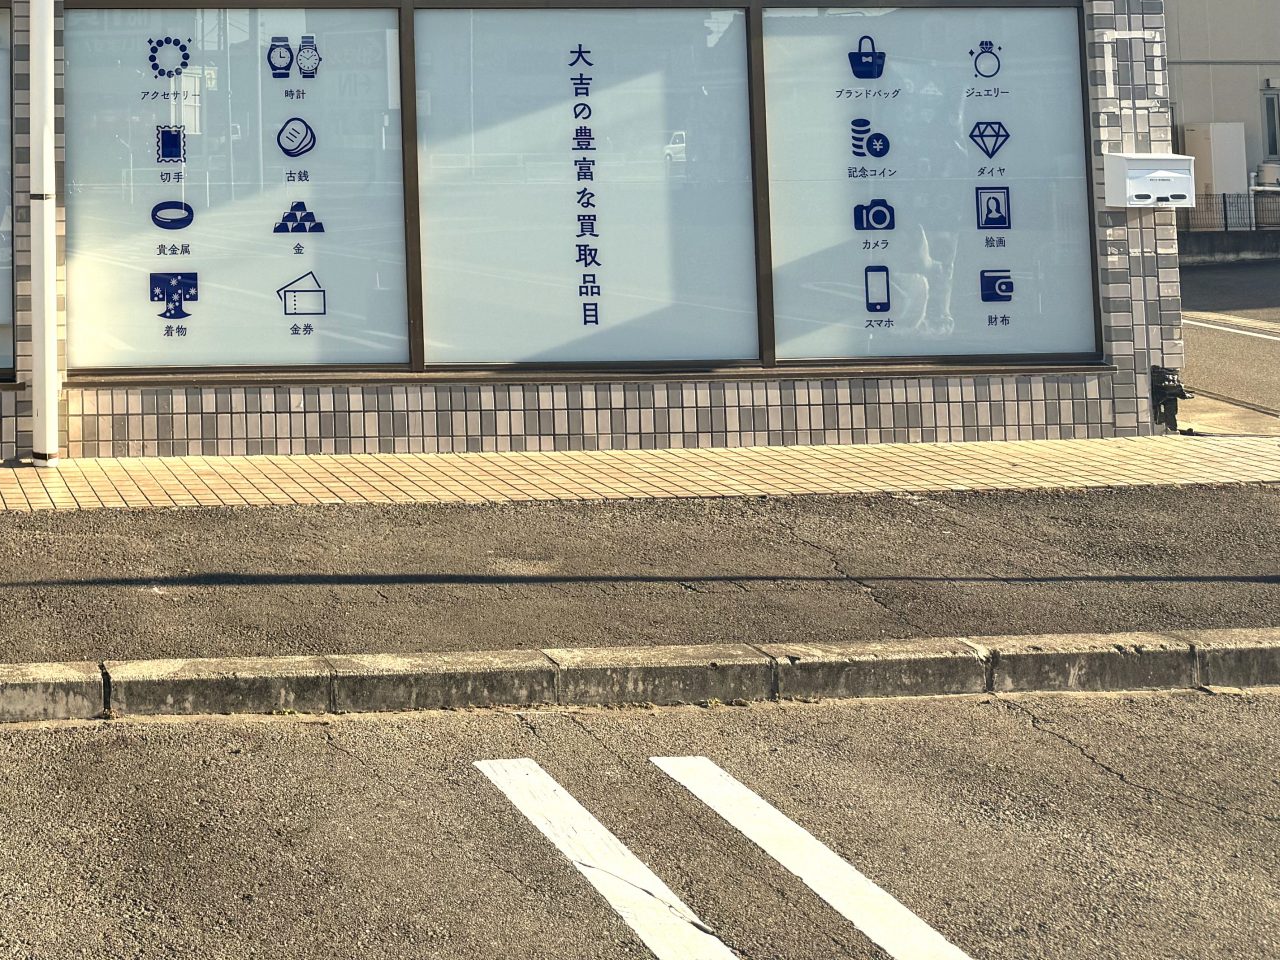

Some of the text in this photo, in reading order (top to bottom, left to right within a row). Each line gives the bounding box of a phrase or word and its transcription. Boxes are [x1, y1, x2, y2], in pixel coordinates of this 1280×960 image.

[140, 91, 200, 100] アクセサリー
[284, 89, 306, 99] 時計
[835, 89, 901, 99] ブランドバッグ
[965, 88, 1010, 97] ジュエリー
[285, 170, 310, 182] 古銭
[848, 166, 897, 178] 記念コイン
[977, 166, 1006, 176] ダイヤ
[160, 171, 184, 183] 切手
[568, 44, 601, 325] 大吉の豊富な買取品目
[862, 239, 889, 250] カメラ
[984, 236, 1006, 248] 絵画
[157, 244, 191, 255] 貴金属
[293, 242, 305, 254] 金
[865, 318, 894, 328] スマホ
[987, 314, 1010, 326] 財布
[163, 325, 187, 336] 着物
[290, 323, 314, 335] 金券
